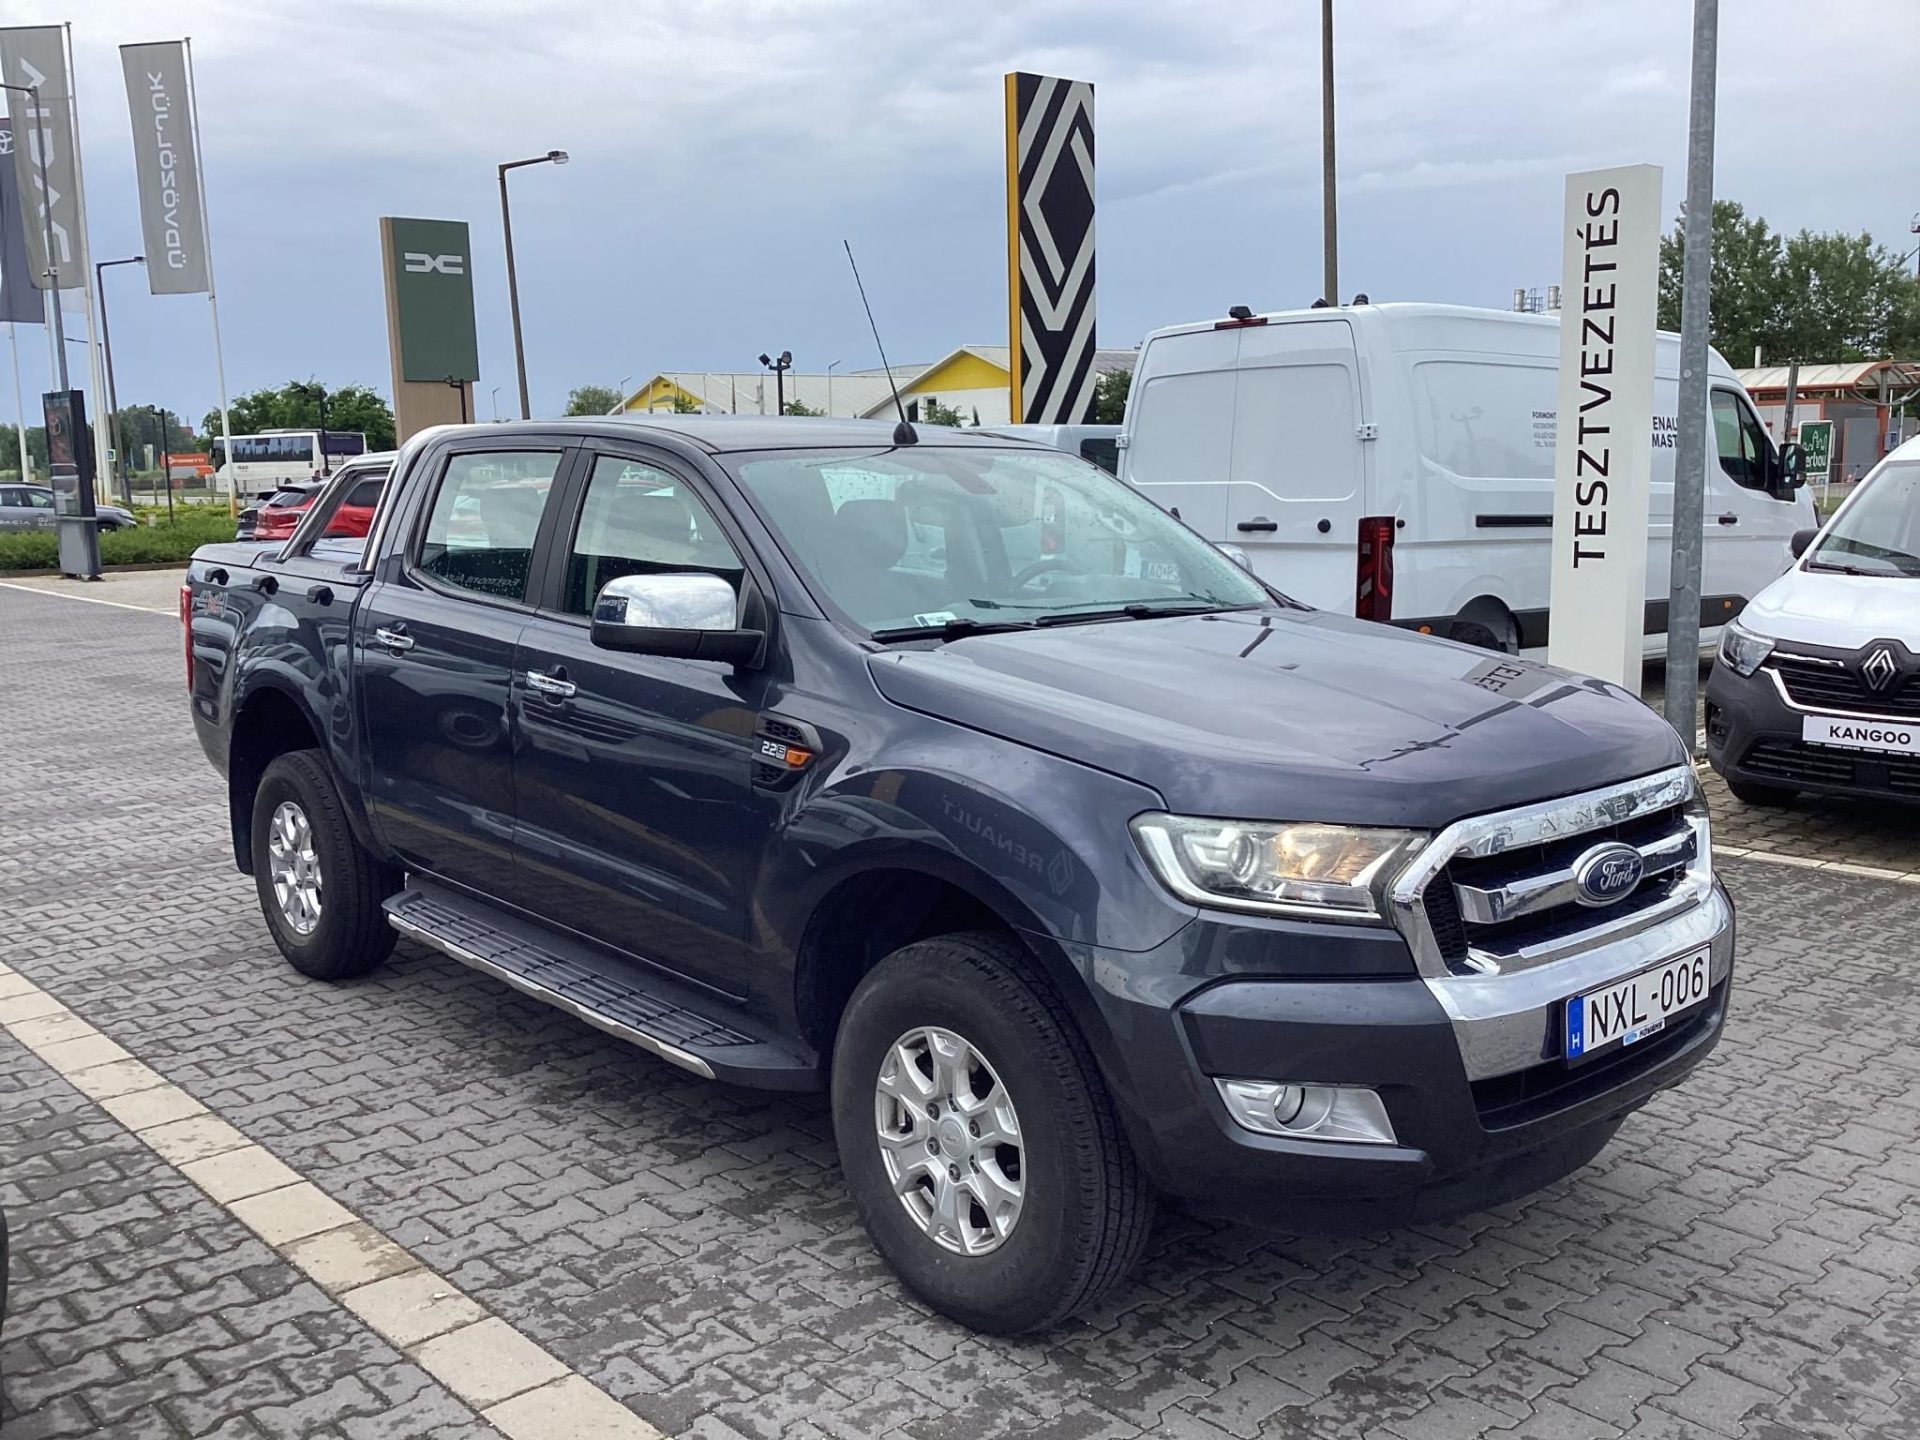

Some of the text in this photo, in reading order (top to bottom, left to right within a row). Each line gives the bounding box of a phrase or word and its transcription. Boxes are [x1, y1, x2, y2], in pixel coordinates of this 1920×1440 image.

[1573, 187, 1620, 568] TESZTVEZETÉS
[1652, 416, 1678, 431] ENAU
[1652, 433, 1678, 448] MAST
[1829, 725, 1911, 745] KANGOO
[1600, 858, 1634, 891] Ford
[1590, 956, 1704, 1044] NXL-006
[1571, 1031, 1580, 1050] H
